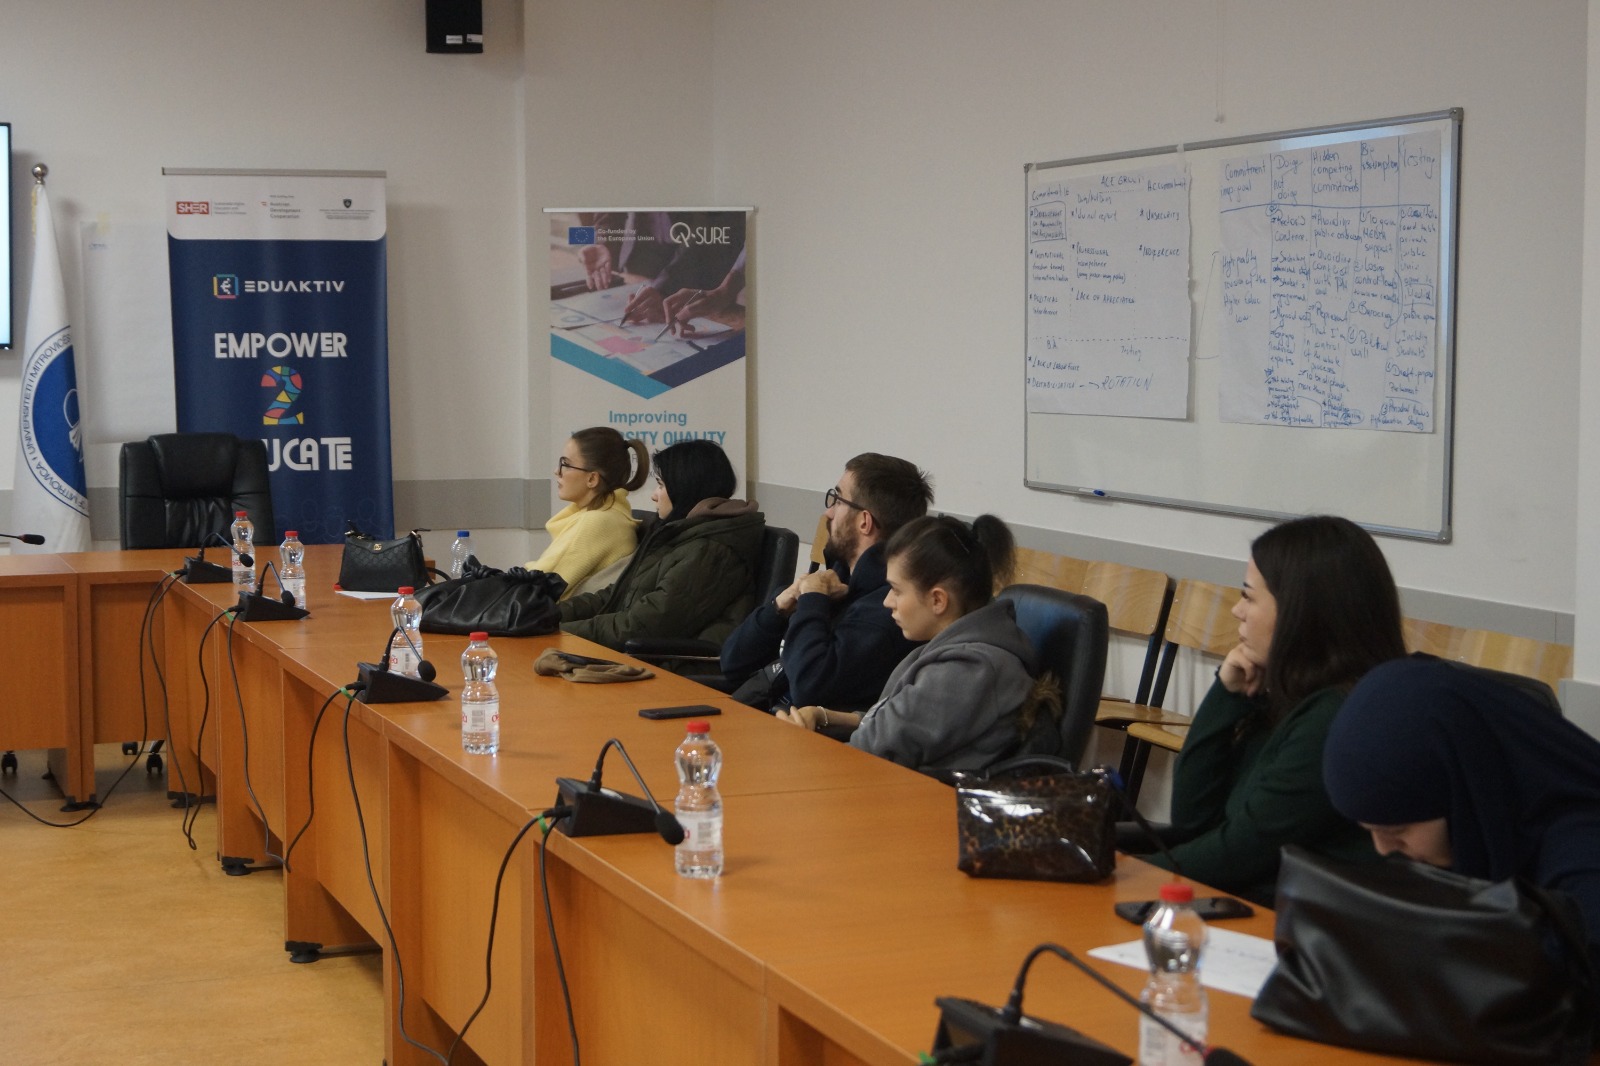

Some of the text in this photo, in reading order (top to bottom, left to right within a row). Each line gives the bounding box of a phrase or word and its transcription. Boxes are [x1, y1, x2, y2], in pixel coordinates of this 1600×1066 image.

[1225, 160, 1266, 180] Commitment
[1402, 147, 1436, 179] Testing
[177, 203, 208, 213] SHER
[244, 280, 345, 293] EDUAKTIV
[214, 332, 348, 359] EMPOWER
[1102, 373, 1154, 391] ROTATION
[260, 365, 305, 426] 2
[609, 410, 688, 426] Improving
[621, 431, 727, 447] SITY QUALITY
[261, 437, 352, 472] UCATE
